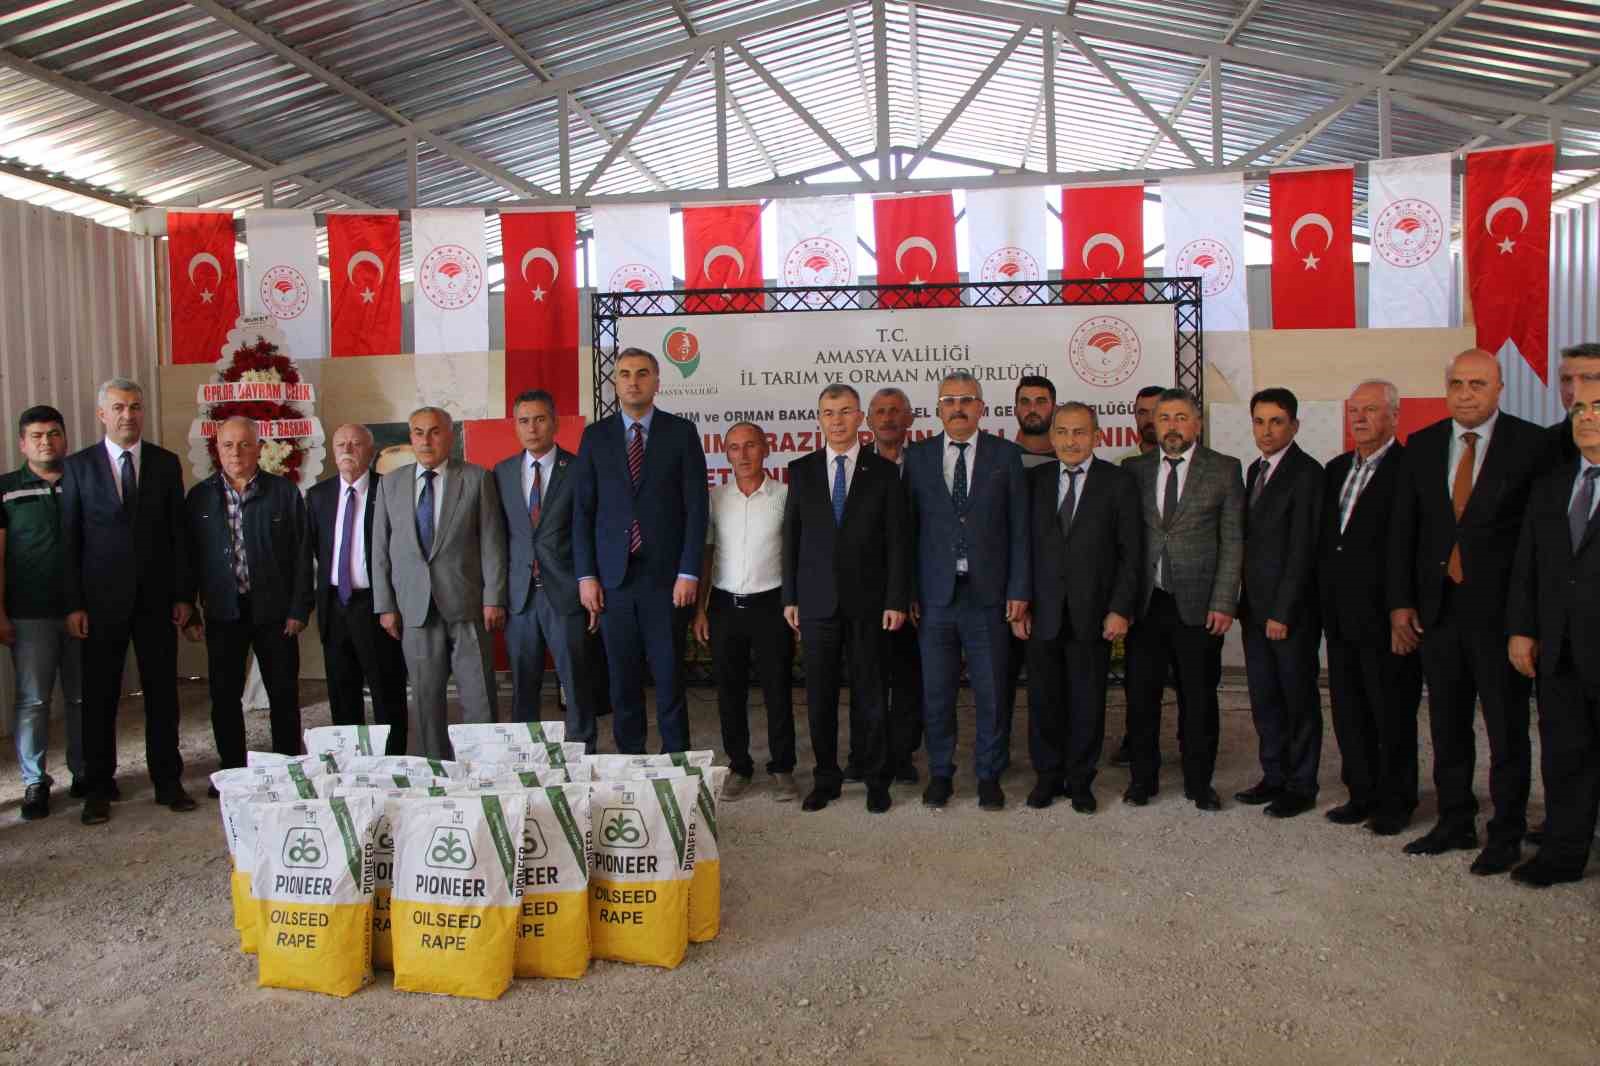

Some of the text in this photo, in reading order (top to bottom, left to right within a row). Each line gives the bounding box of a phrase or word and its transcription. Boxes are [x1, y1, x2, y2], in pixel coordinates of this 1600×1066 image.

[876, 328, 908, 342] T.C.
[815, 345, 971, 364] AMASYA VALİLİĞİ
[740, 370, 757, 386] İL
[761, 370, 820, 385] TARIM
[850, 368, 918, 385] ORMAN
[704, 413, 719, 423] ve
[724, 410, 774, 422] ORMAN
[684, 824, 696, 871] PIONEER
[364, 842, 375, 895] PIONEER
[515, 846, 526, 898] PIONEER
[594, 852, 658, 874] PIONEER
[275, 874, 333, 896] PIONEER
[415, 874, 485, 897] PIONEER
[595, 886, 657, 904] OILSEED
[270, 909, 329, 927] OILSEED
[413, 910, 482, 929] OILSEED
[600, 908, 643, 925] RAPE
[276, 932, 316, 949] RAPE
[421, 934, 466, 951] RAPE
